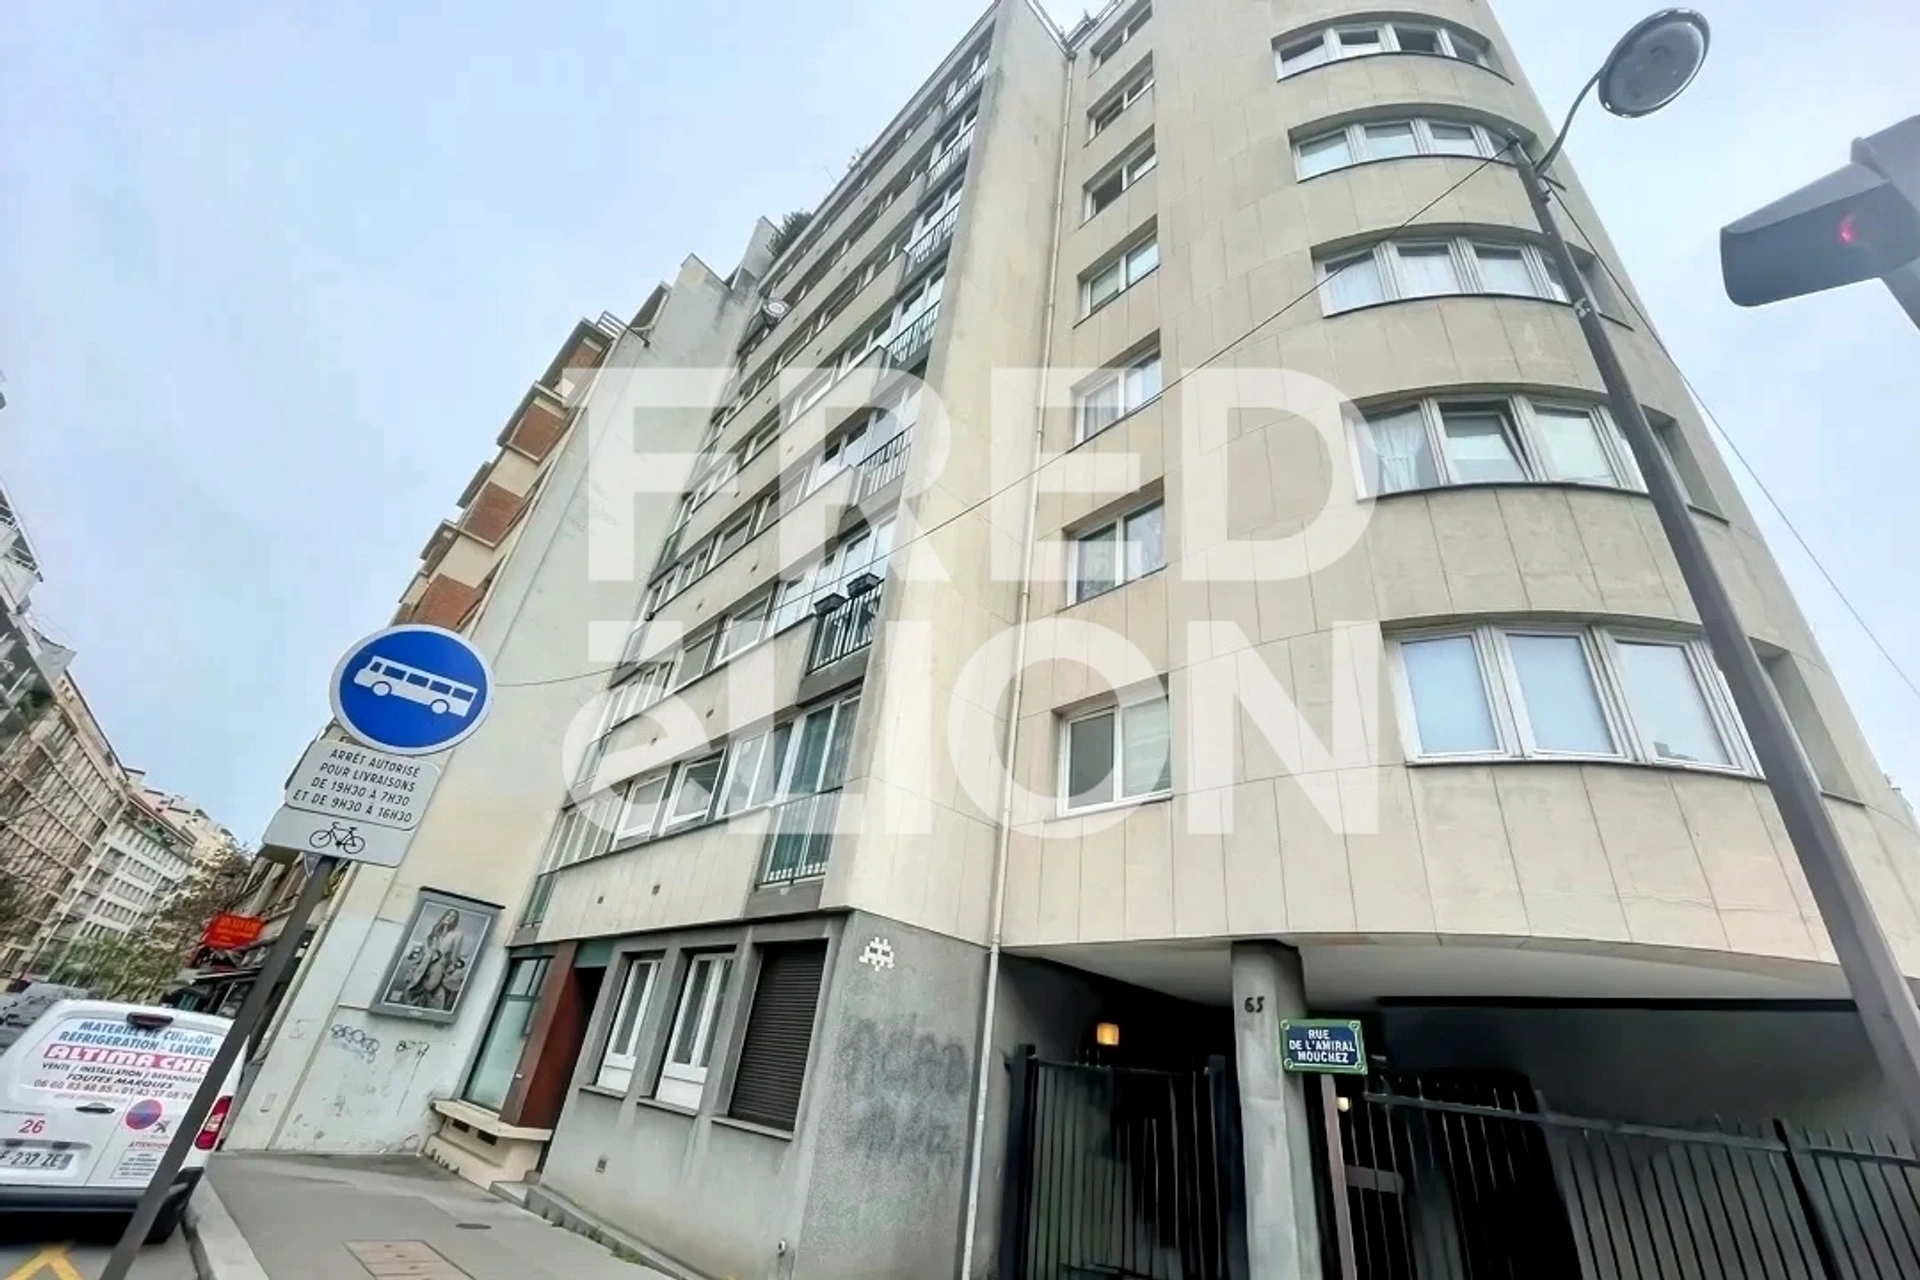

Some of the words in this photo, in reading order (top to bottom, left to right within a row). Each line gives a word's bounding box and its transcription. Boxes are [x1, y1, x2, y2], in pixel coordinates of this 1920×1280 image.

[319, 762, 350, 777] POUR
[352, 769, 416, 792] LIVRAISONS
[310, 776, 328, 789] DE
[330, 780, 367, 798] 19H30
[380, 791, 410, 807] 7H30
[293, 789, 309, 801] ET
[311, 793, 328, 806] DE
[331, 797, 362, 812] 9H30
[378, 807, 412, 822] 16H30
[1244, 995, 1265, 1013] 65
[1308, 1029, 1331, 1040] RUE
[1289, 1040, 1303, 1050] DE
[1305, 1040, 1356, 1052] L'AMIRAL
[47, 1044, 155, 1067] ALTIMA
[1297, 1051, 1349, 1064] MOUCHEZ
[66, 1073, 113, 1083] TOUTES
[113, 1078, 175, 1089] MARQUES
[18, 1119, 46, 1134] 26
